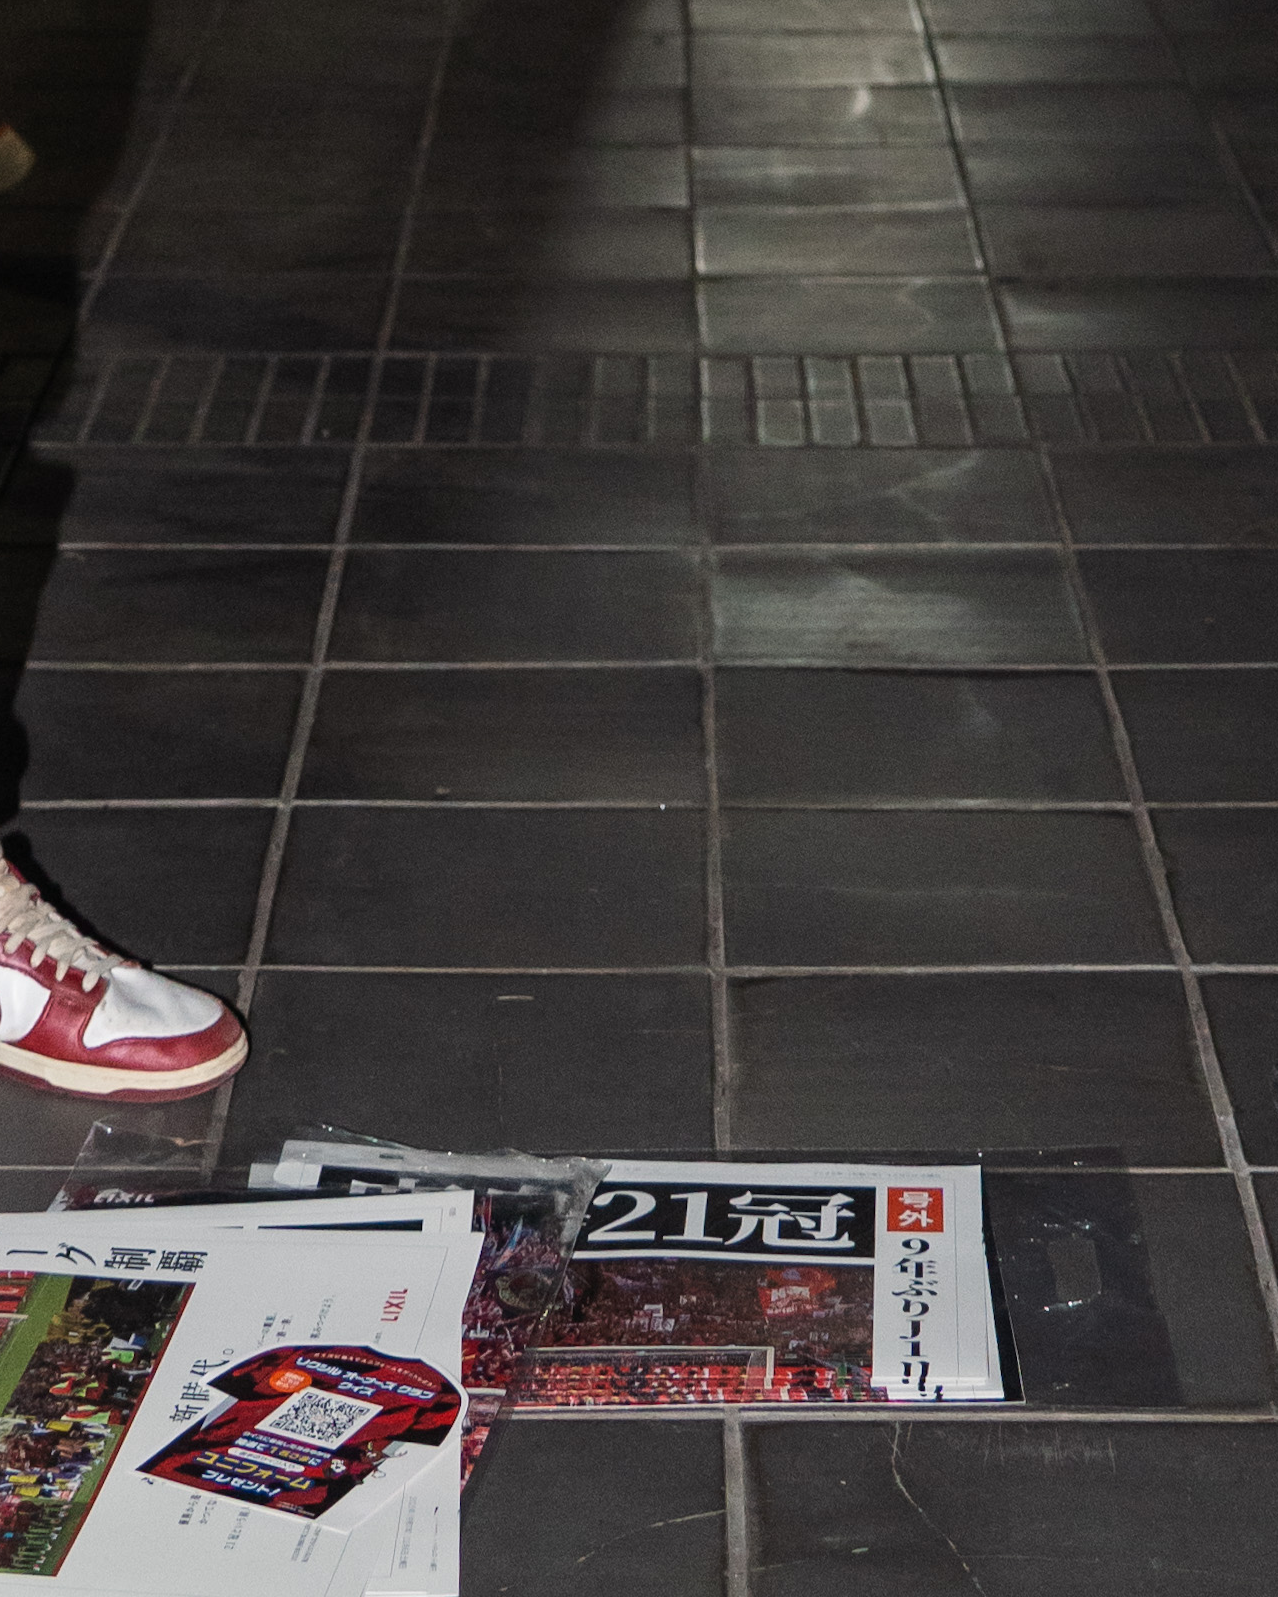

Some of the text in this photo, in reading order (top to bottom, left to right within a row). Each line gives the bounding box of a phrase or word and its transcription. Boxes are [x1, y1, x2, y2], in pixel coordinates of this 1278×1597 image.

[586, 1189, 857, 1249] 21冠
[898, 1191, 934, 1229] 号外
[380, 1287, 409, 1324] LIXIL
[195, 1450, 315, 1491] ユニフォーム
